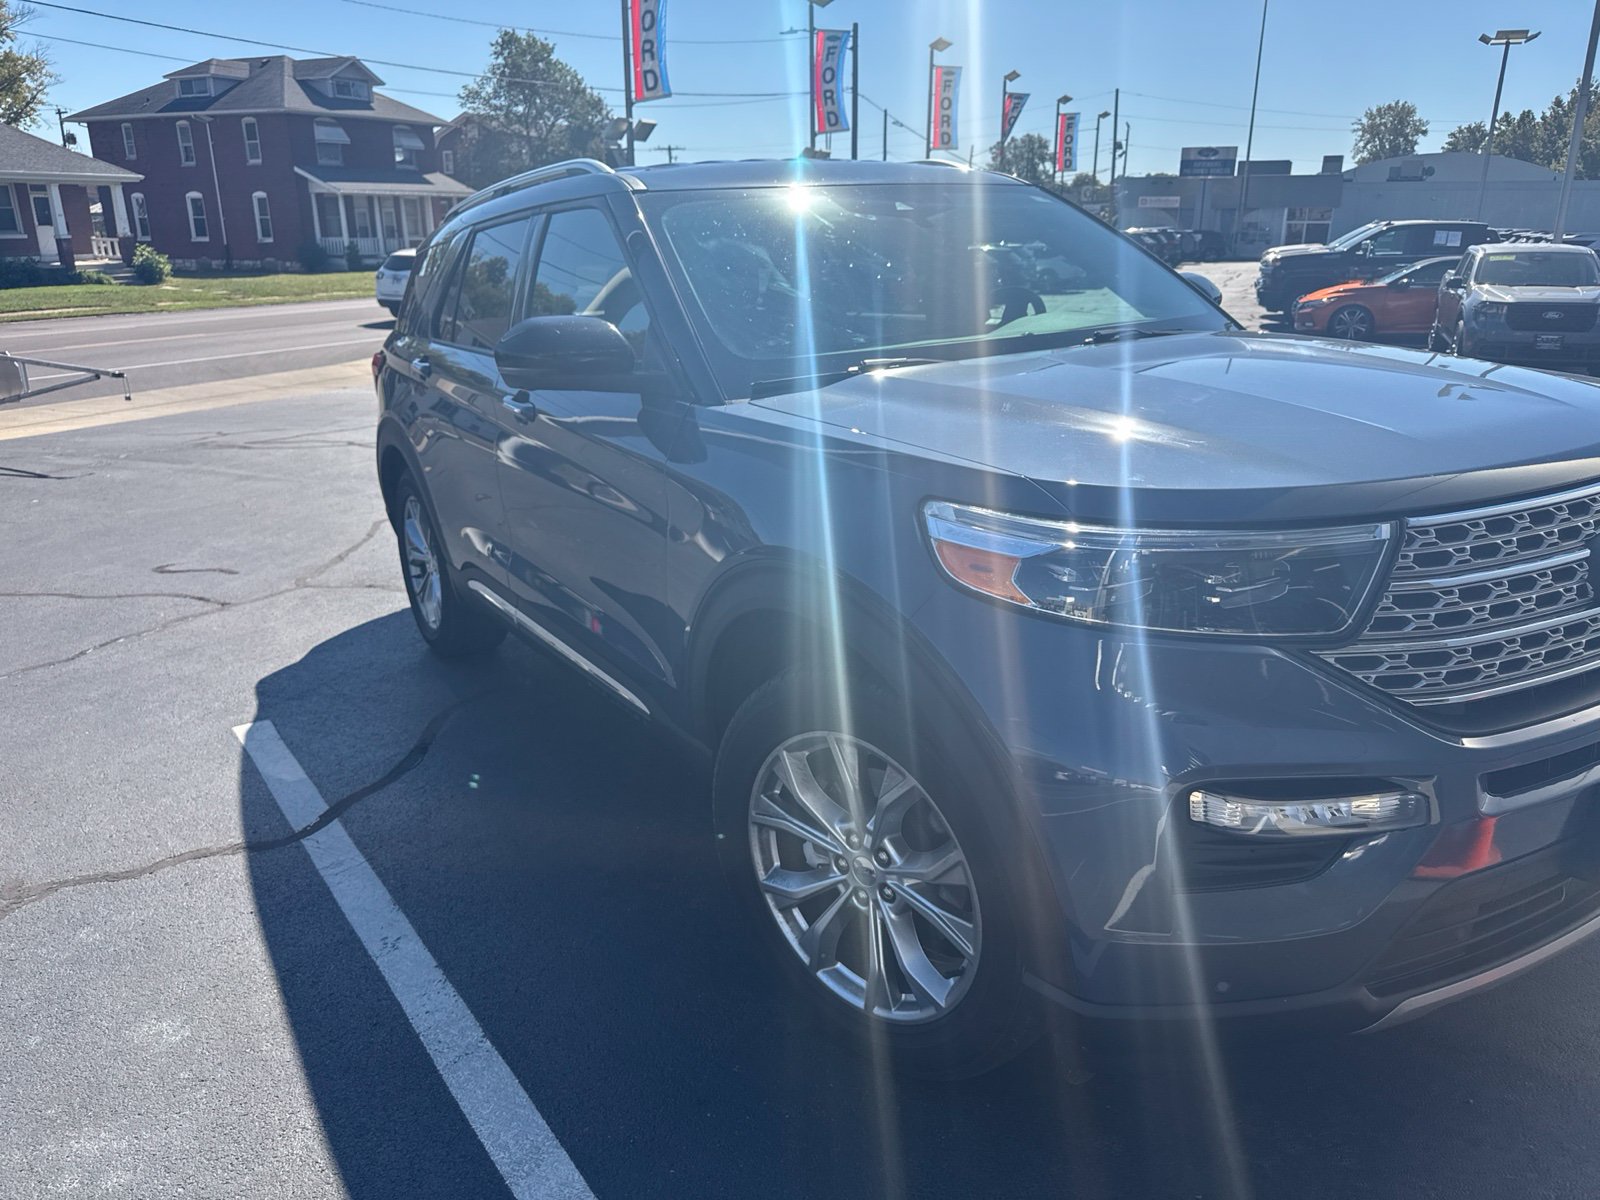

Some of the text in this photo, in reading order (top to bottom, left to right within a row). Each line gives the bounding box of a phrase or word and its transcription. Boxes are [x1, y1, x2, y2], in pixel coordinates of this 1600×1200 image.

[641, 0, 659, 92] ORD
[822, 46, 840, 127] FORD
[940, 79, 953, 146] FORD
[1064, 122, 1075, 168] FORD
